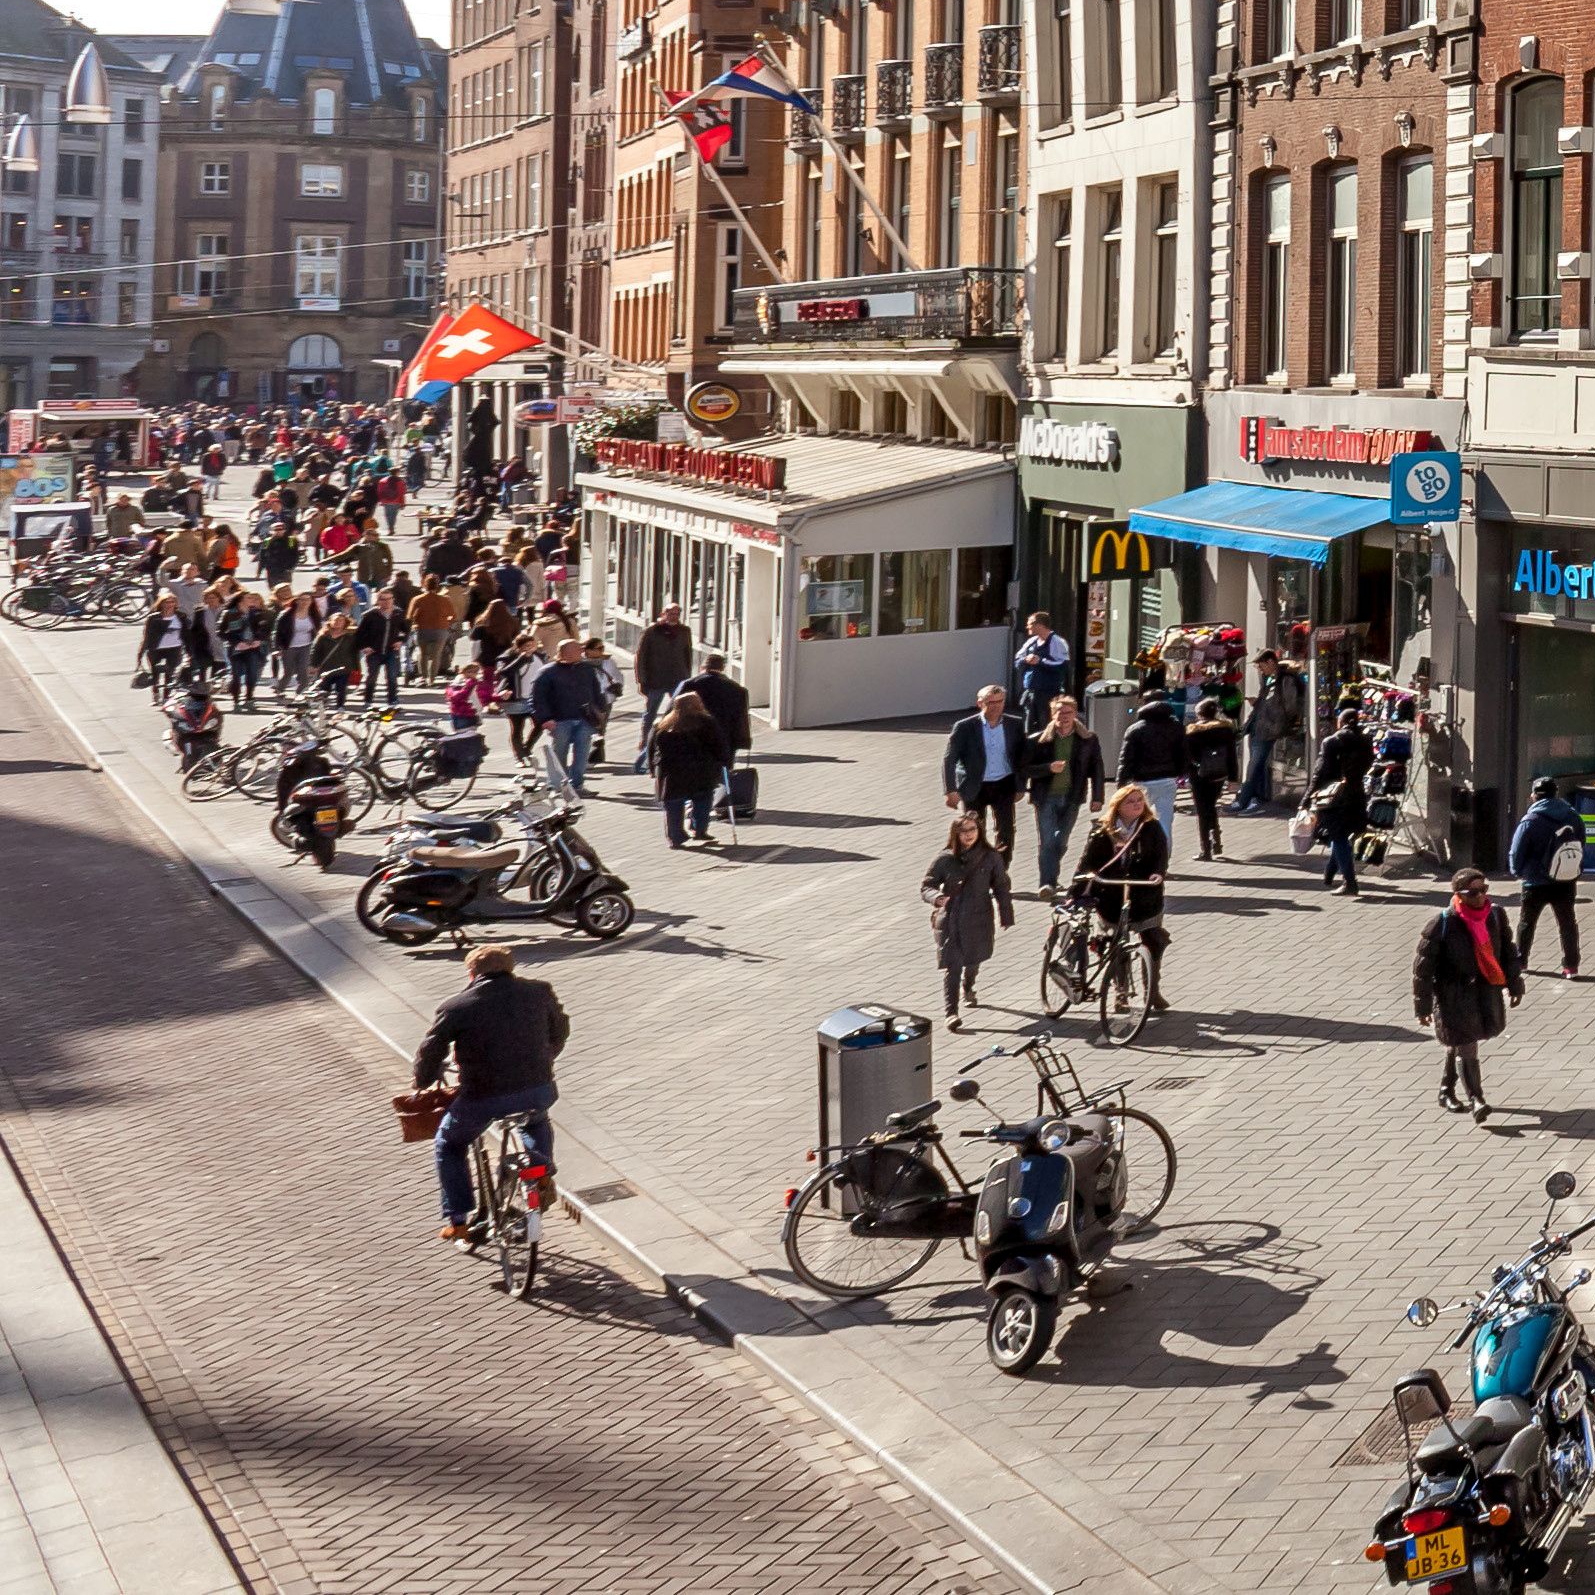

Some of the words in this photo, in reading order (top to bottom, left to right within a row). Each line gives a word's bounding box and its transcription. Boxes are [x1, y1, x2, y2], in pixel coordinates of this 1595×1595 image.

[1019, 416, 1114, 463] McDonald's
[1414, 466, 1437, 484] to
[1421, 477, 1446, 501] go
[1425, 1533, 1450, 1554] ML
